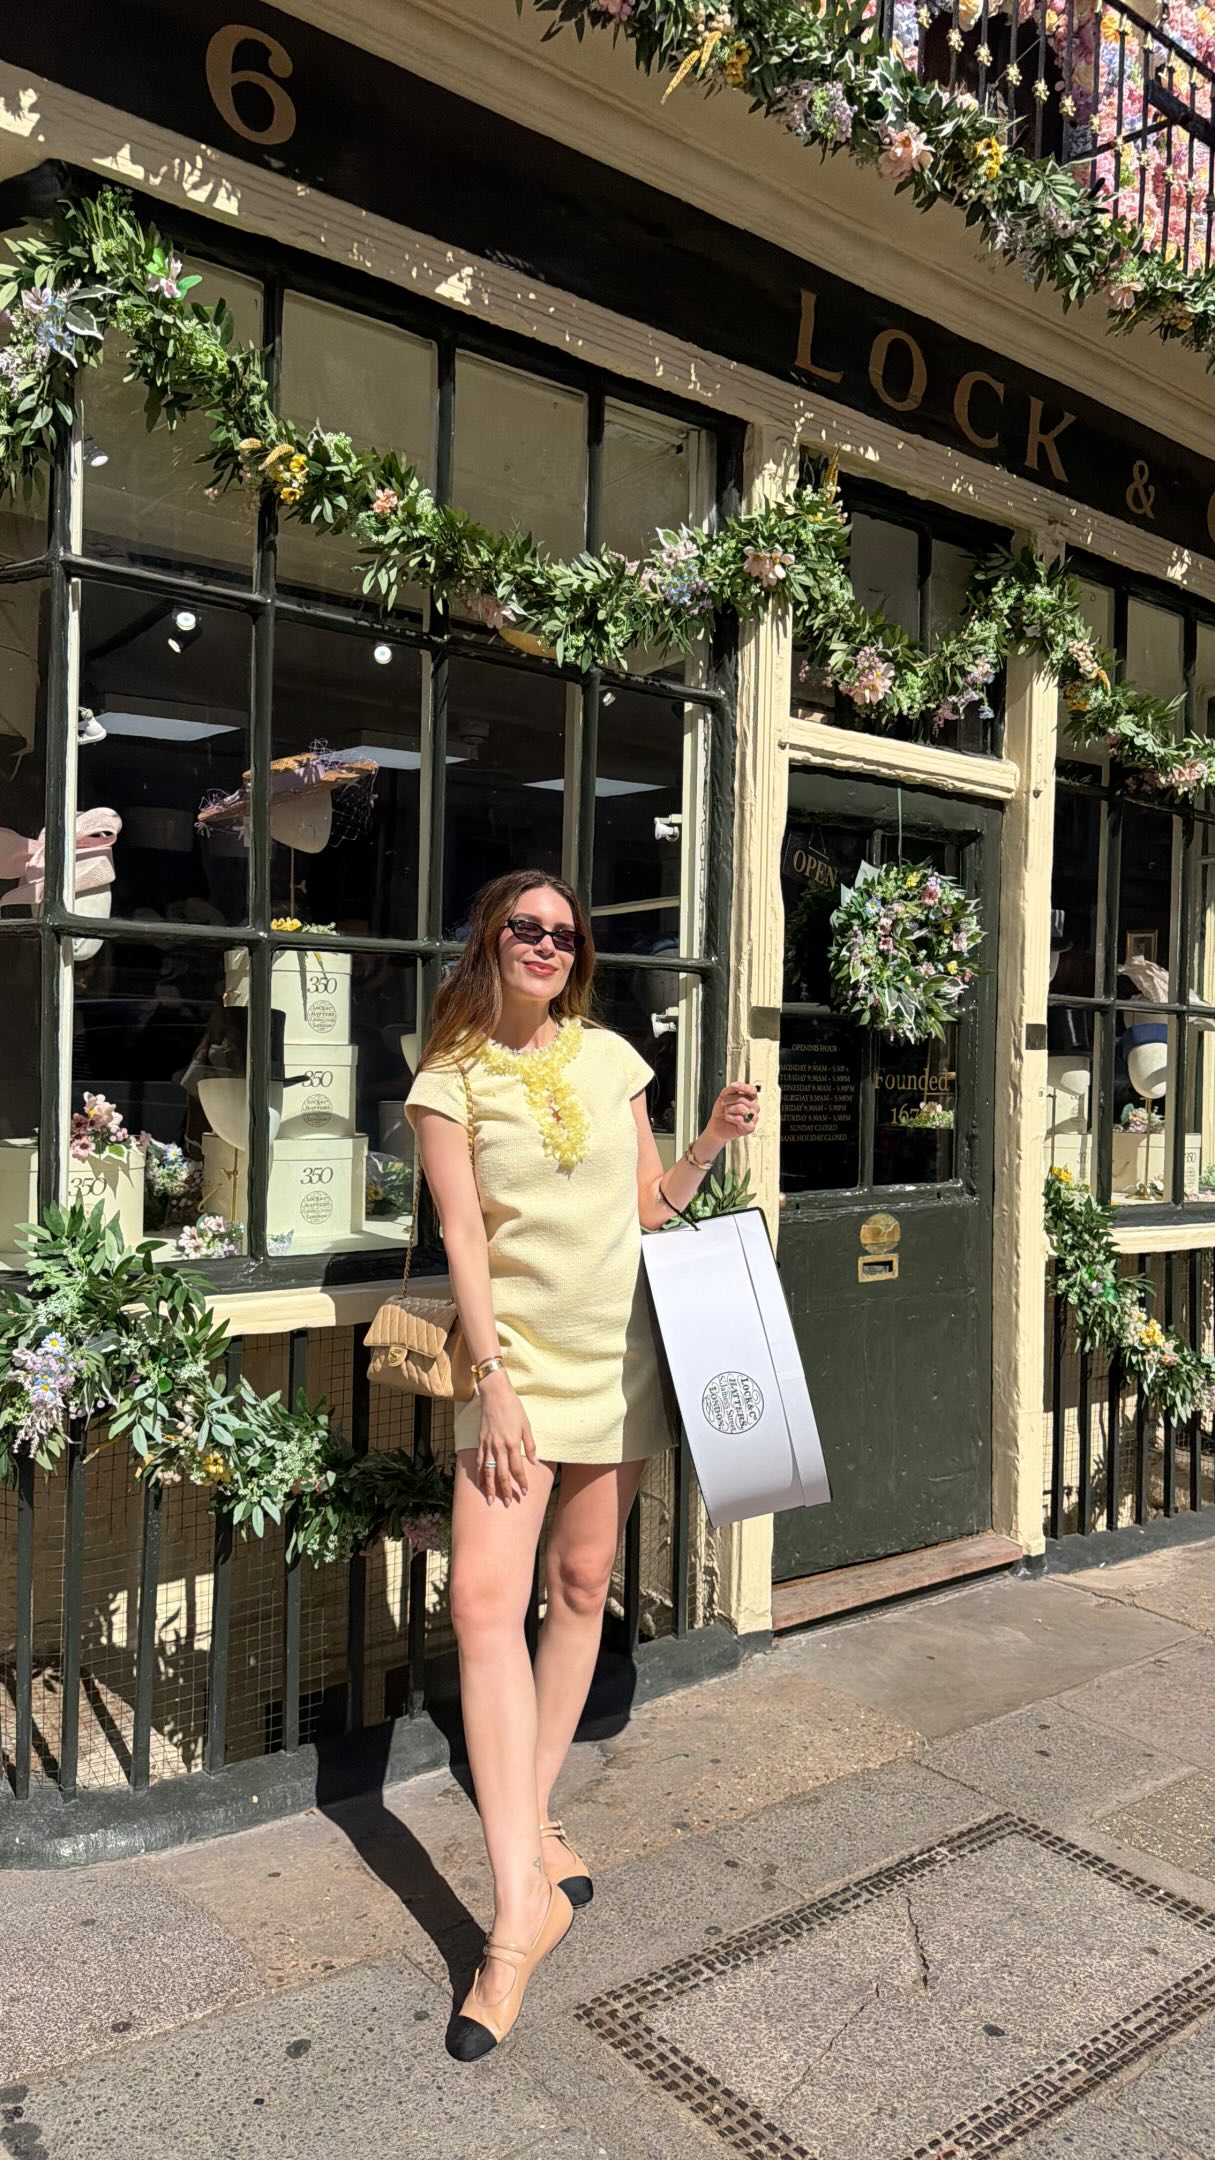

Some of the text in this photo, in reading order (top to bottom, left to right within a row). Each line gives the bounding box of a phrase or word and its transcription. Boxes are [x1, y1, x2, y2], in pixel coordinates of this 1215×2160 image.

[206, 24, 297, 146] 6
[794, 288, 1079, 483] LOCK
[1126, 460, 1155, 519] &
[793, 850, 838, 890] OPEN
[307, 976, 337, 994] 350
[302, 1071, 333, 1087] 350
[781, 1084, 811, 1092] EDNESDAY
[873, 1066, 949, 1091] Founded
[890, 1103, 920, 1125] 167
[824, 1133, 848, 1141] CLOSED
[300, 1167, 334, 1184] 350
[68, 1178, 107, 1196] 350
[702, 1850, 949, 1973] POST OFFICE TELEPHONES
[954, 1988, 1200, 2150] POST OFFICE TELEPHONES
